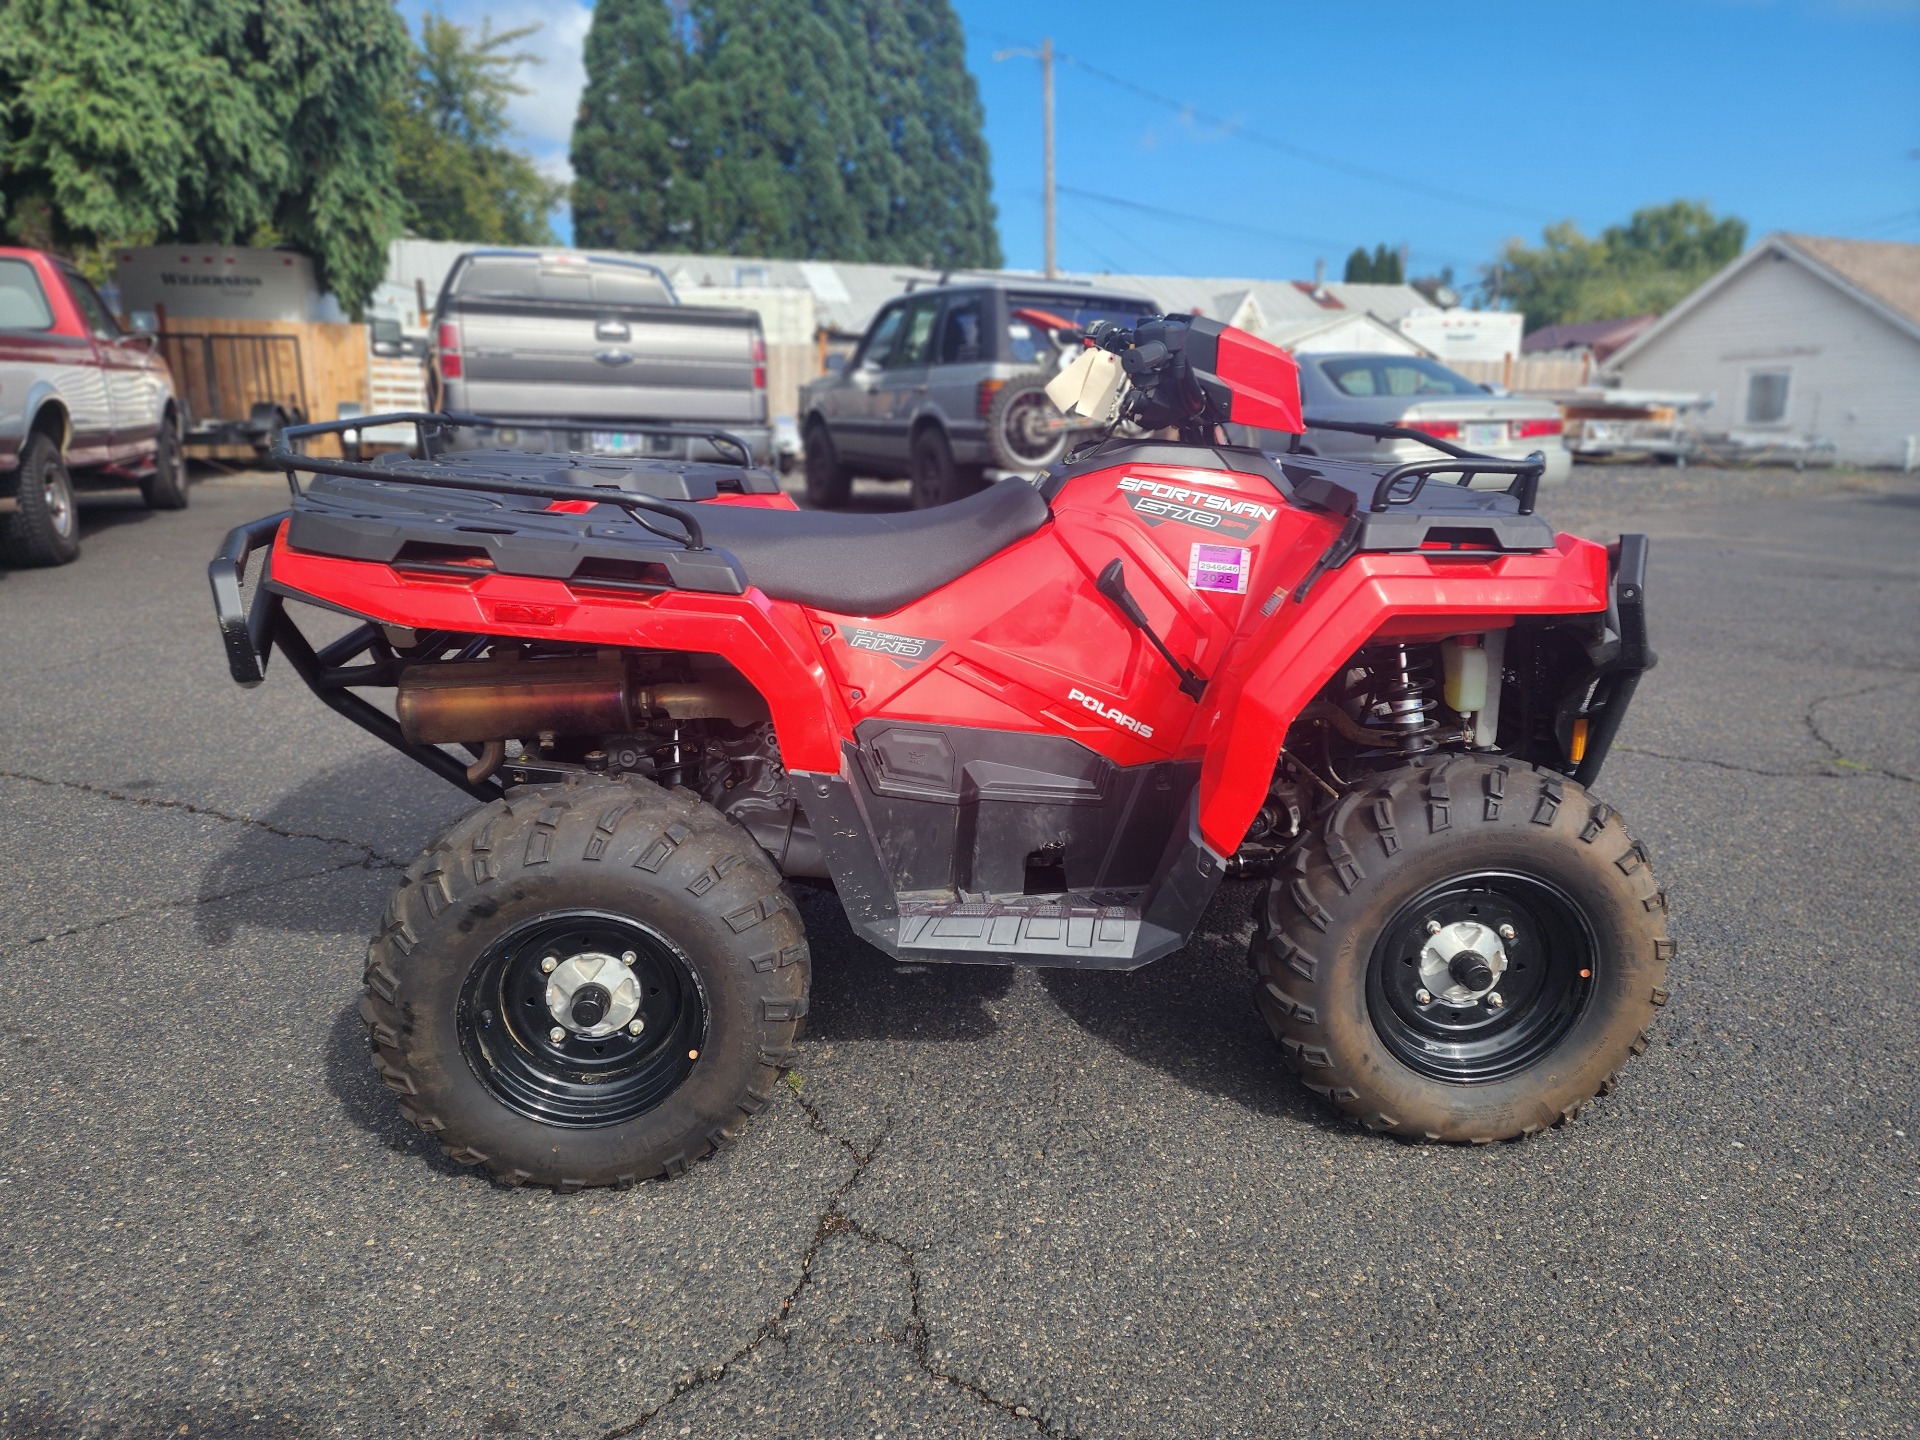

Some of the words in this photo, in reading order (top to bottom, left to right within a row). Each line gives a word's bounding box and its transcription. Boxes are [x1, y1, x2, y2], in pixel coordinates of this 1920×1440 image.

[1116, 476, 1277, 521] SPORTSMAN
[1134, 497, 1221, 527] 570
[1200, 562, 1238, 572] 2946646
[1202, 573, 1233, 584] 2025
[850, 634, 923, 657] AWD
[877, 632, 926, 645] DEMAND
[1067, 687, 1155, 738] POLARIS
